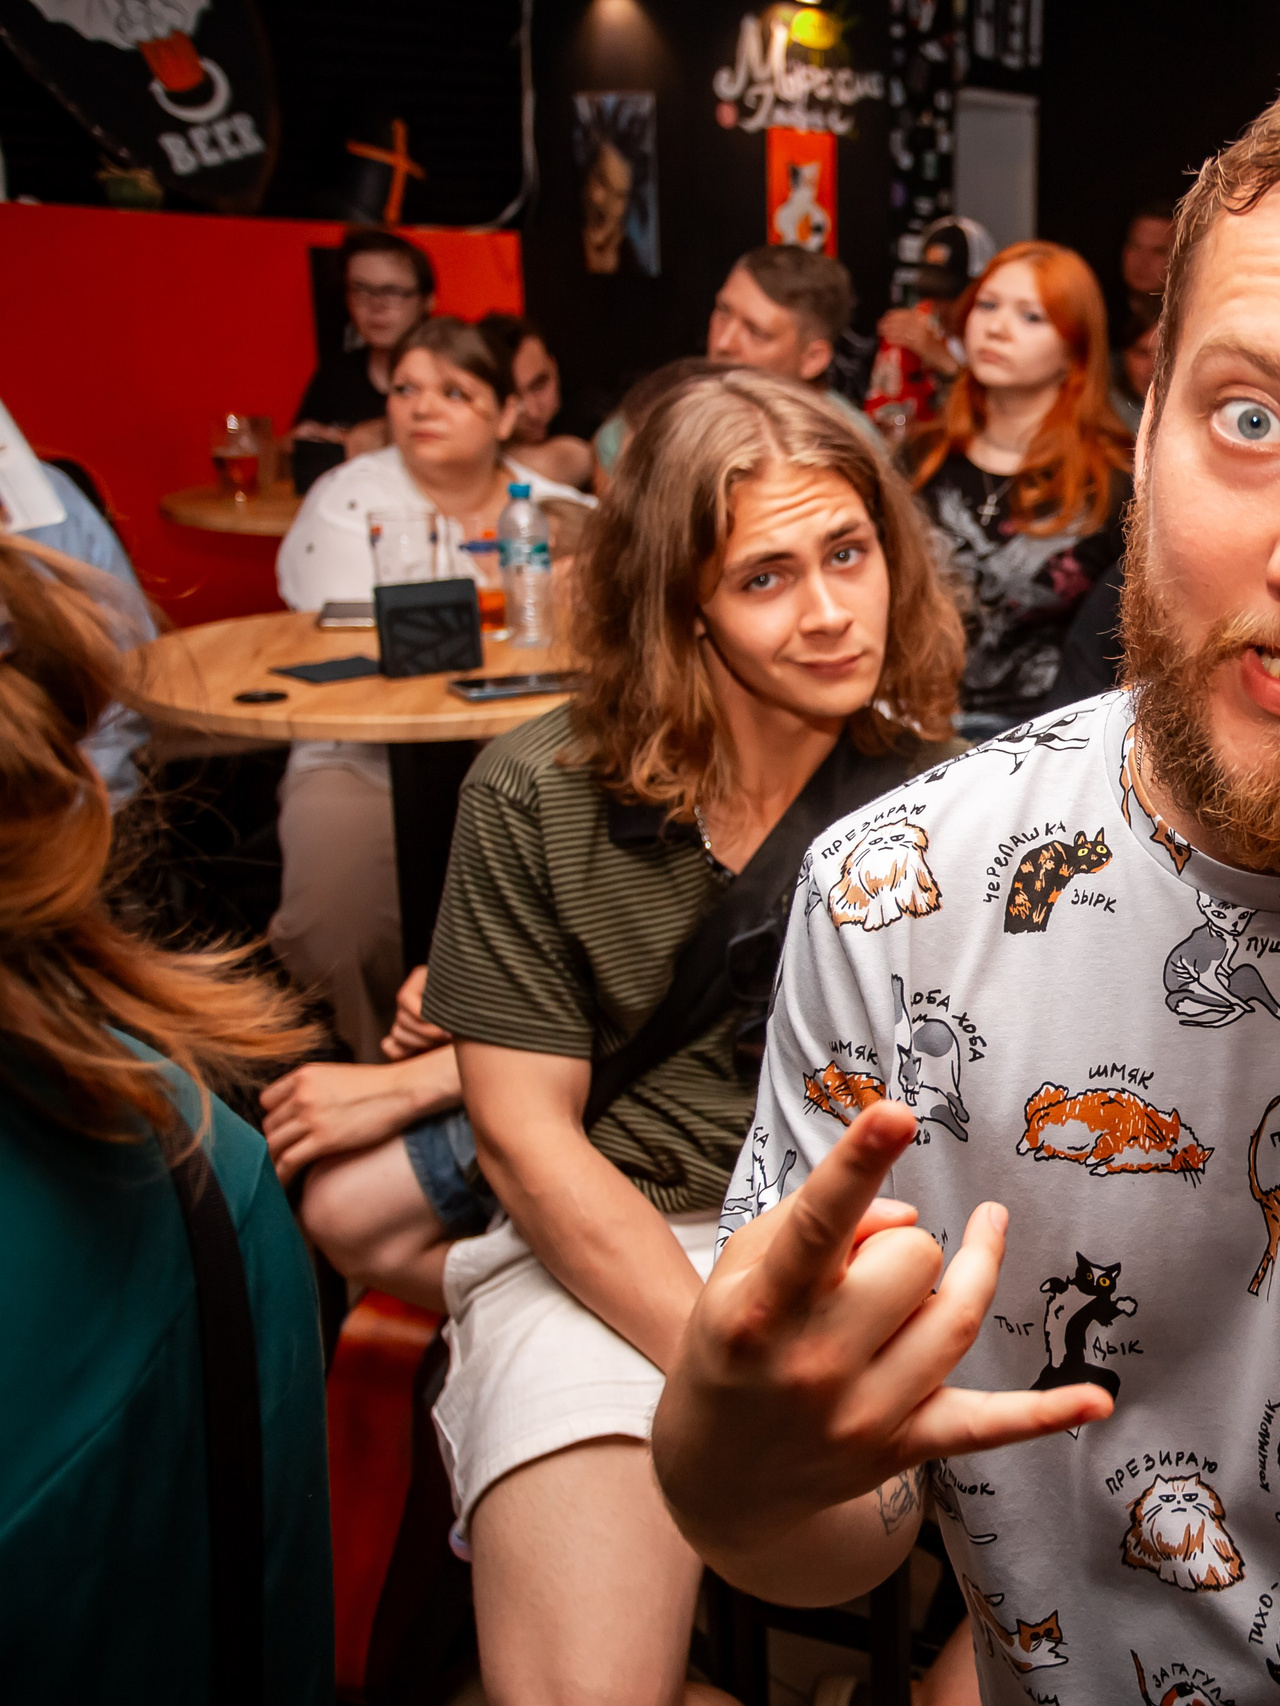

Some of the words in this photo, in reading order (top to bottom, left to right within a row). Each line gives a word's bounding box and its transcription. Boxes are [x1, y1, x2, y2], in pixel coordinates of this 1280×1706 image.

[158, 112, 266, 175] BEER
[821, 804, 927, 860] ПРЕЗИРАЮ
[1071, 888, 1117, 914] ЗЫРК
[1089, 1062, 1155, 1090] ШМЯК
[1105, 1450, 1219, 1495] ПРЕЗИРАЮ
